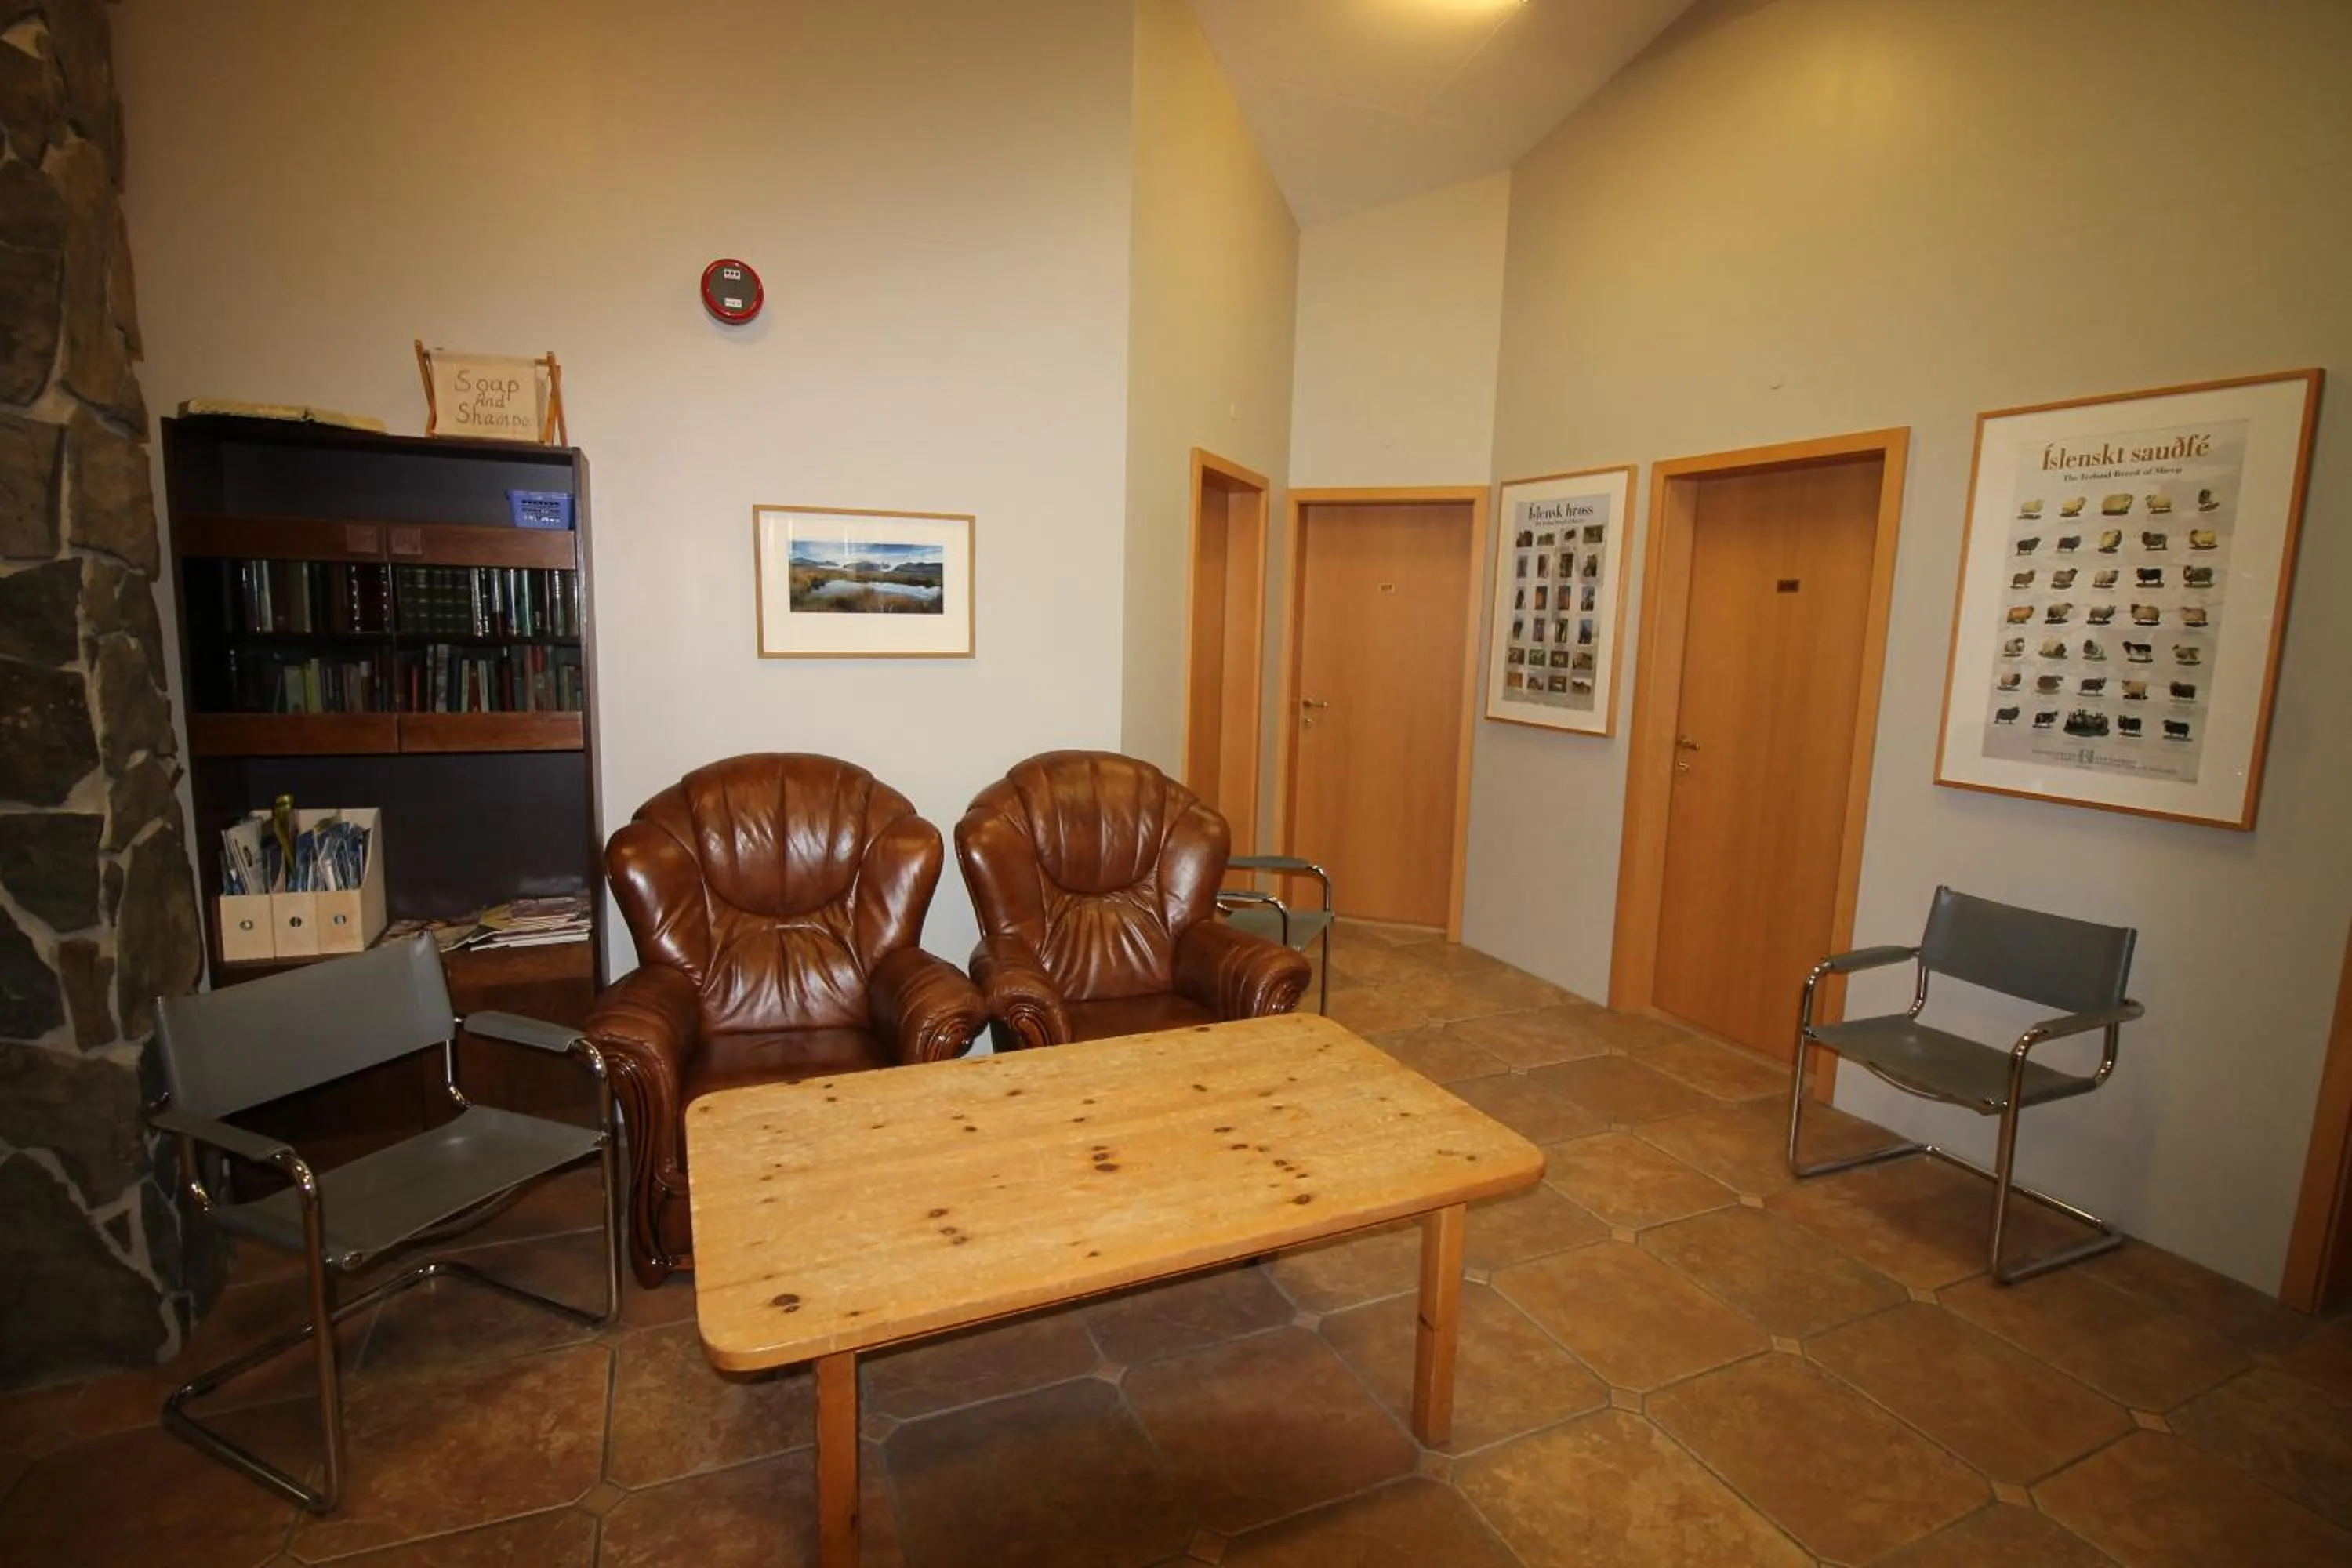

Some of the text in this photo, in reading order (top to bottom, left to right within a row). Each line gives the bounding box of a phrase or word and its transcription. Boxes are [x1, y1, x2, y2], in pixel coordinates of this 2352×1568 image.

[454, 369, 520, 401] Soap
[475, 394, 505, 408] And
[2042, 434, 2212, 470] Íslenskt sauðfé
